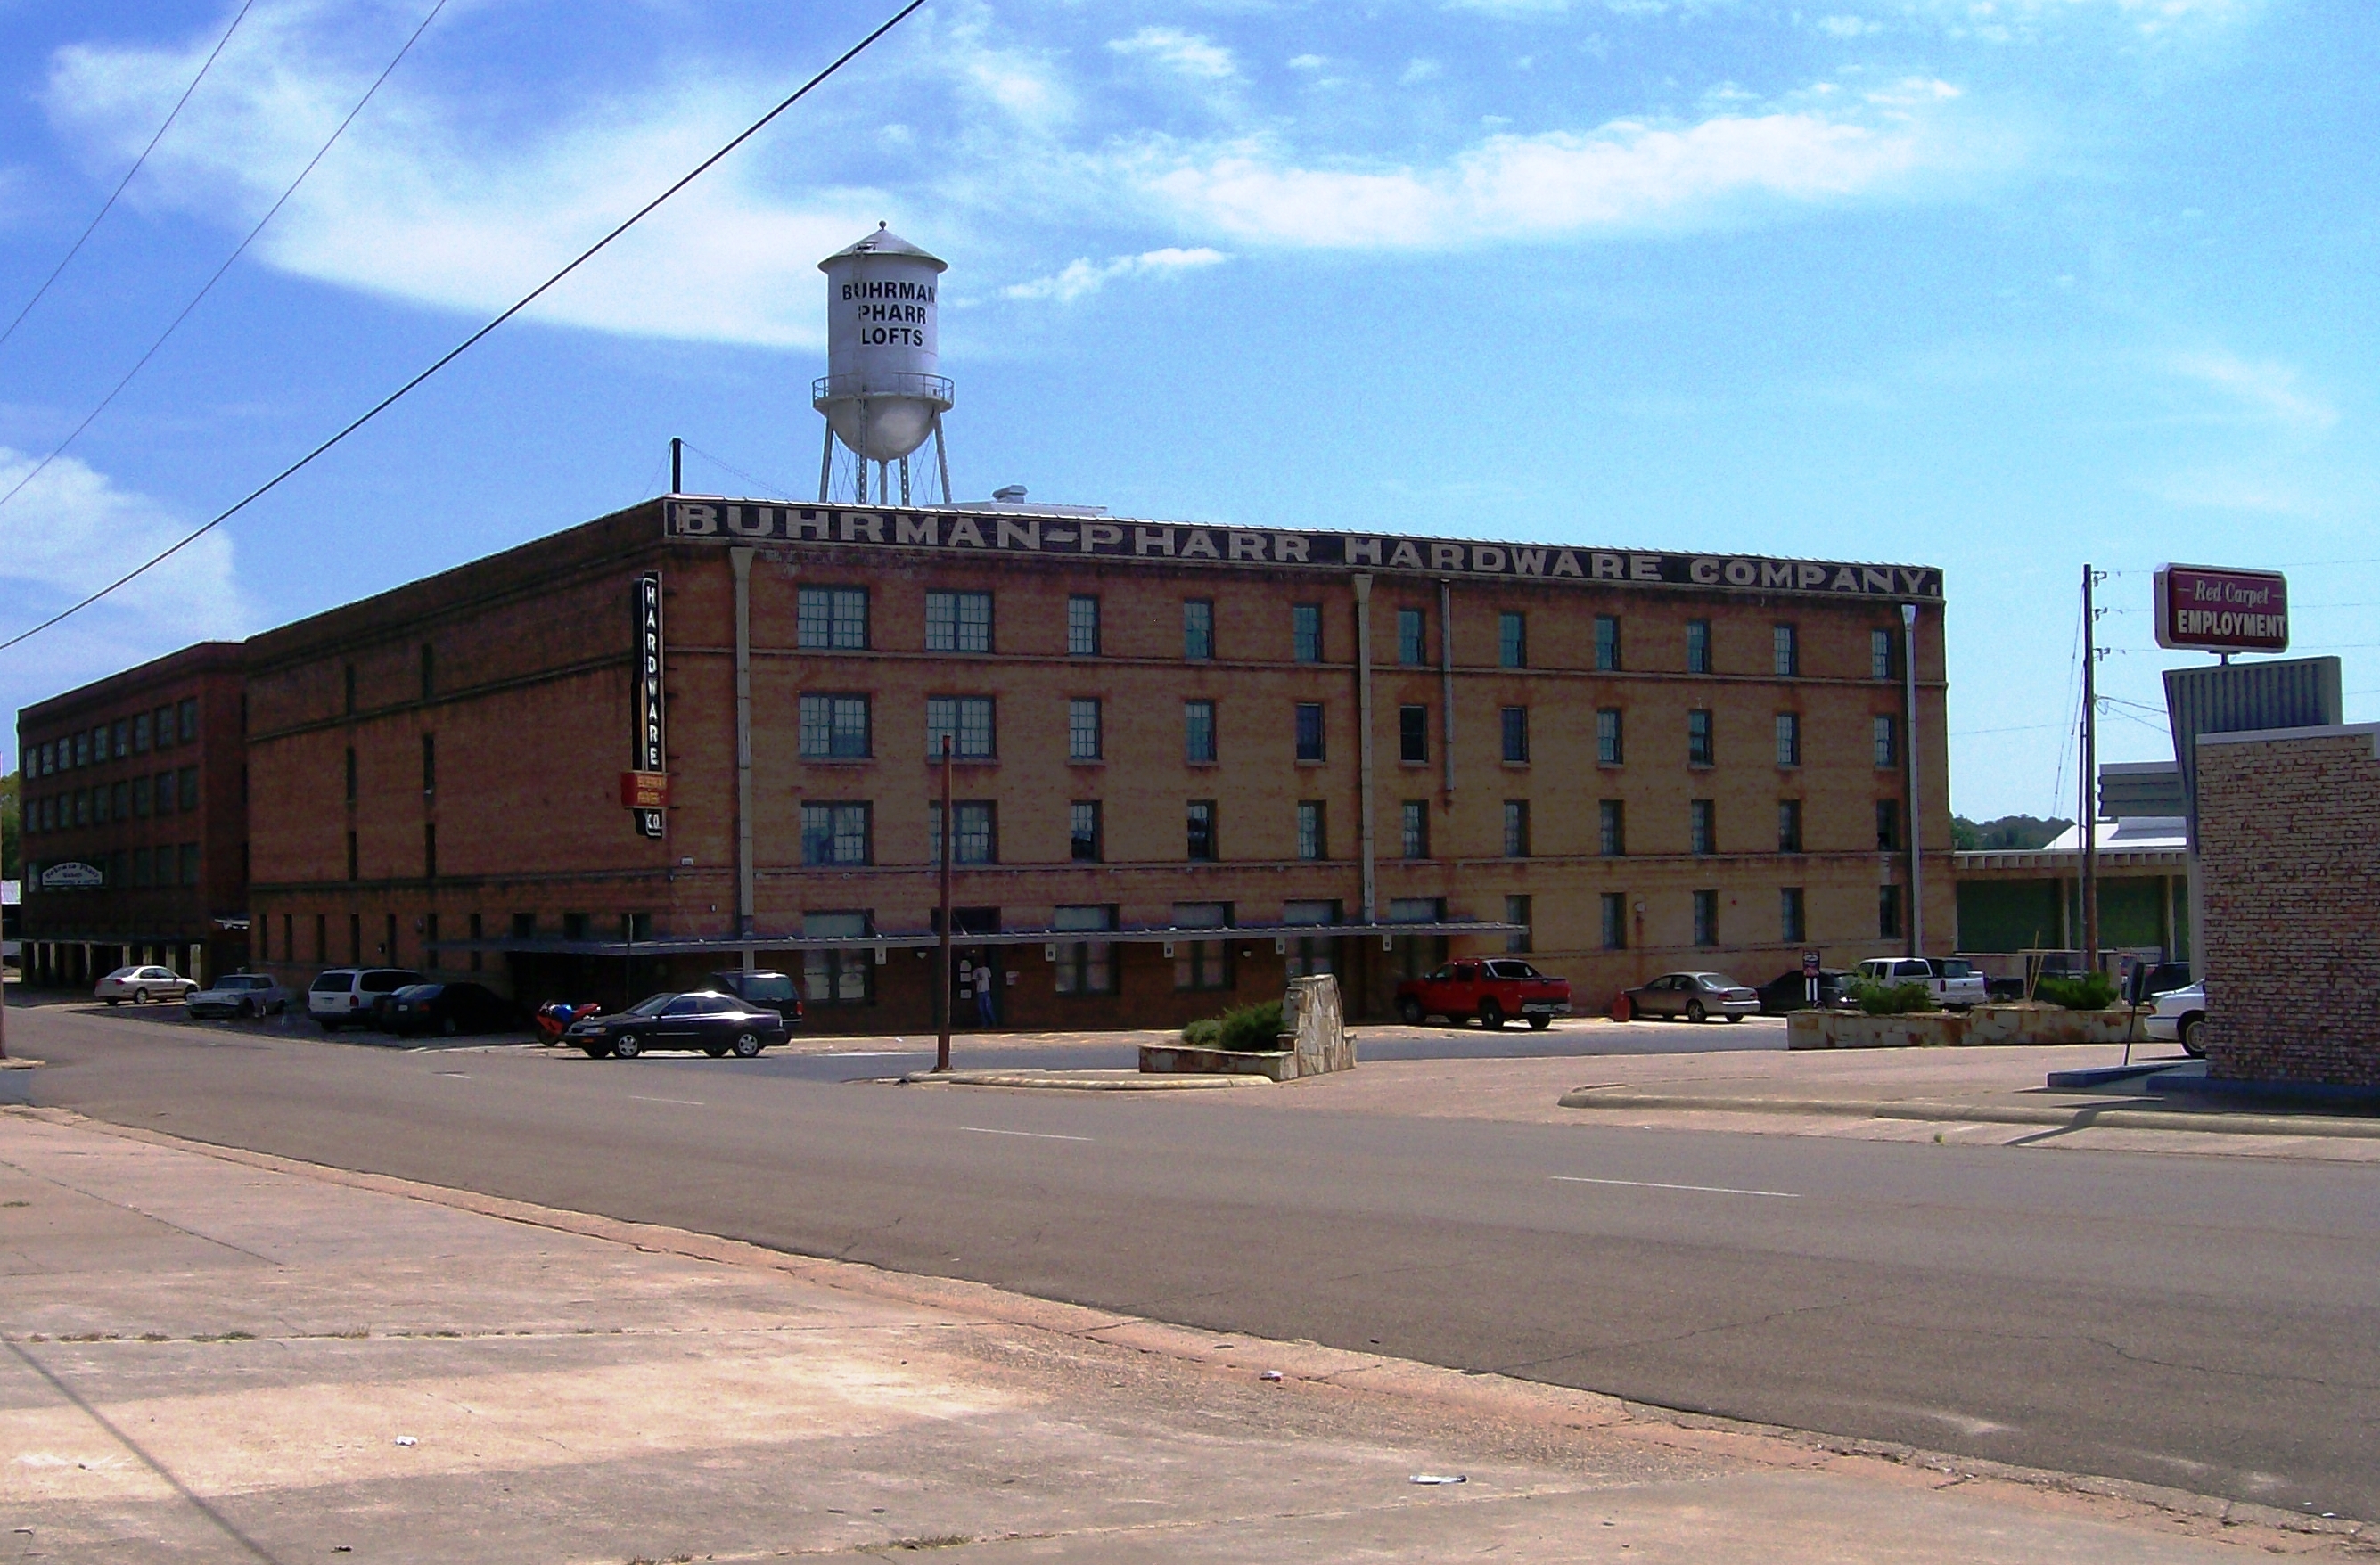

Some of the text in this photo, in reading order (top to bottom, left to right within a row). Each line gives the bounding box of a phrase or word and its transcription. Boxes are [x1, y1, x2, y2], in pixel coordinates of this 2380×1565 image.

[842, 281, 936, 303] BUHRMAN
[858, 304, 926, 324] PHARR
[861, 327, 923, 347] LOFTS
[1344, 537, 1662, 581] HARDWARE
[2194, 579, 2269, 608] Red Carpet
[2177, 609, 2286, 638] EMPLOYMENT
[646, 586, 659, 766] HARDWARE
